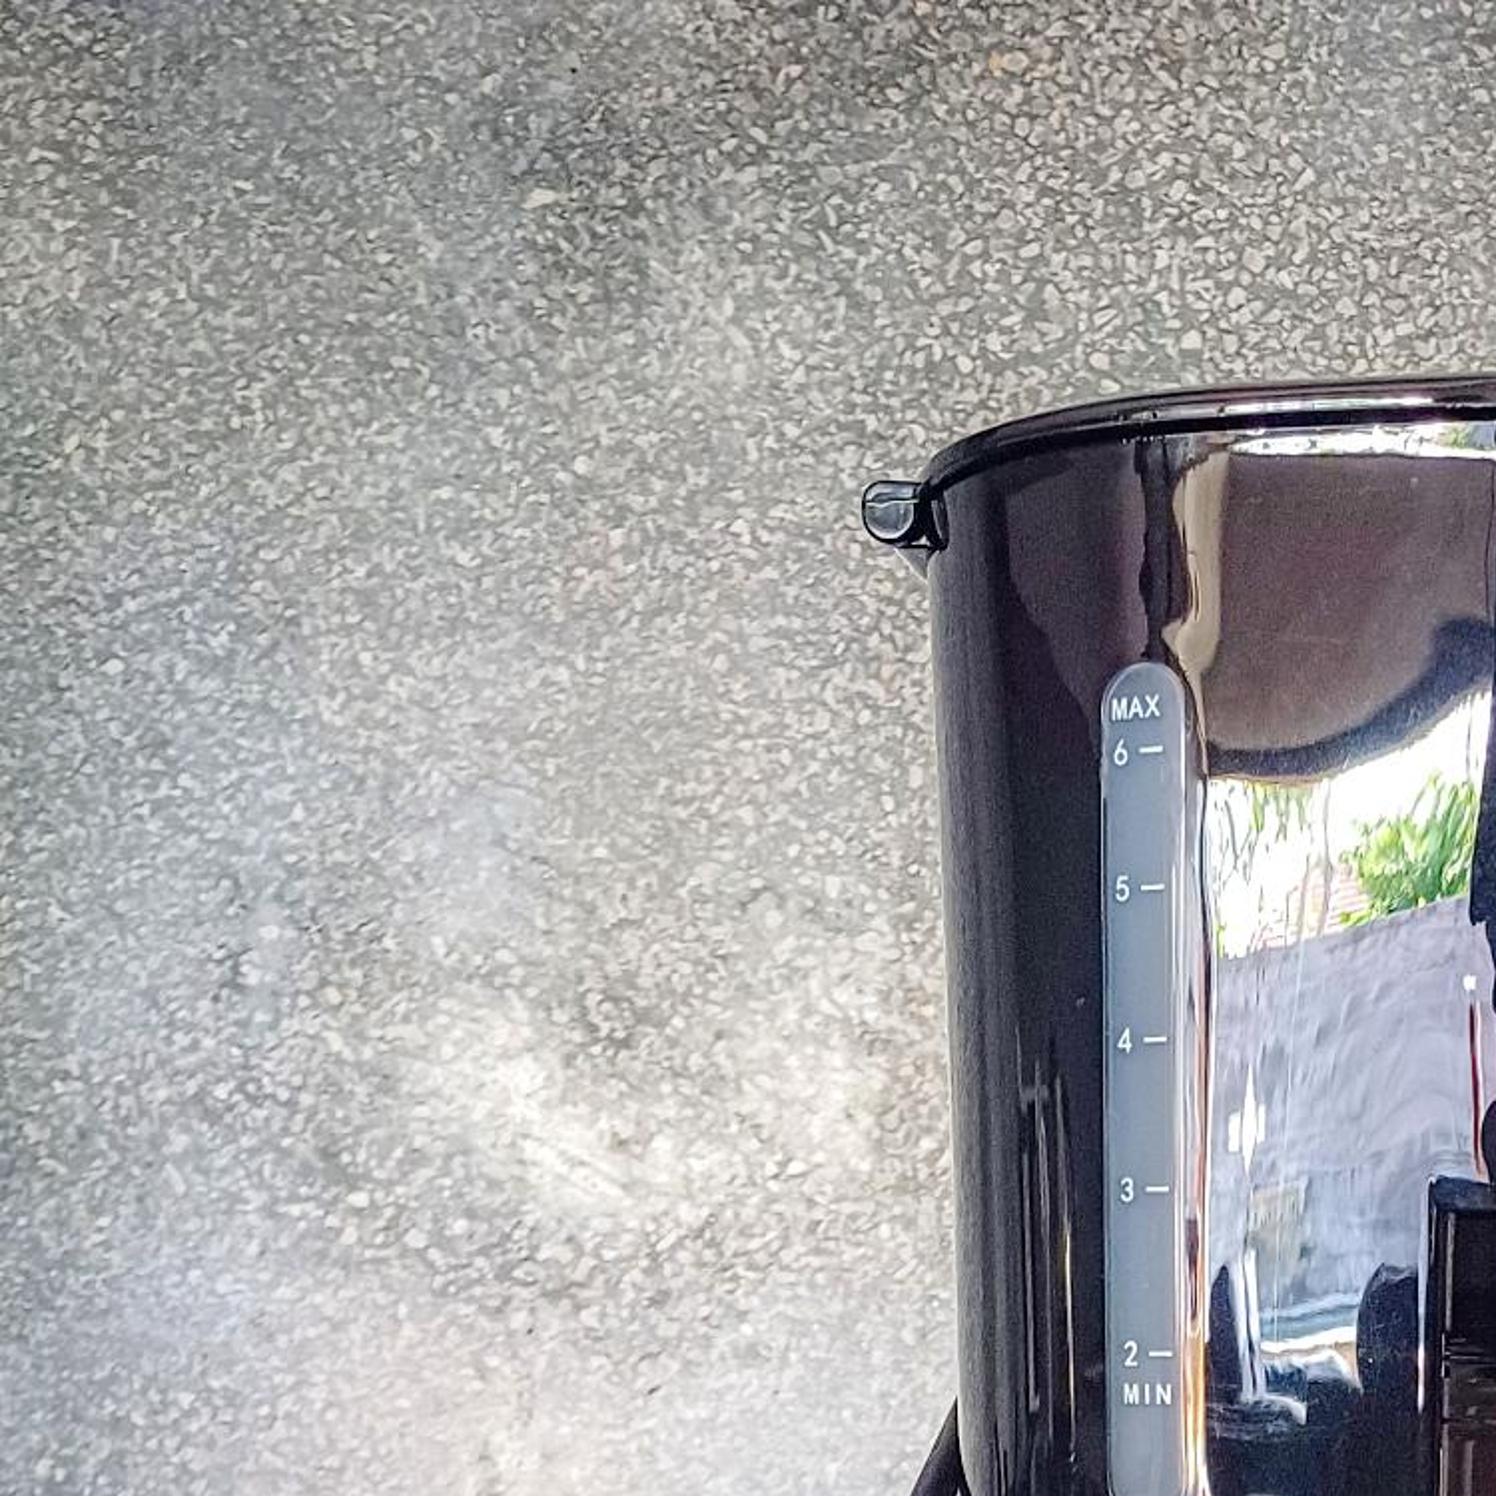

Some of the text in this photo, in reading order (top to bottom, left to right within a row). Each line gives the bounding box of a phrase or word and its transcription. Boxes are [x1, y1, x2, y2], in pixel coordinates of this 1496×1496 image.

[1111, 694, 1161, 721] MAX
[1113, 738, 1128, 766] 6
[1115, 875, 1130, 902] 5
[1117, 1027, 1133, 1054] 4
[1120, 1177, 1134, 1203] 3
[1123, 1340, 1139, 1367] 2
[1122, 1382, 1173, 1406] MIN
